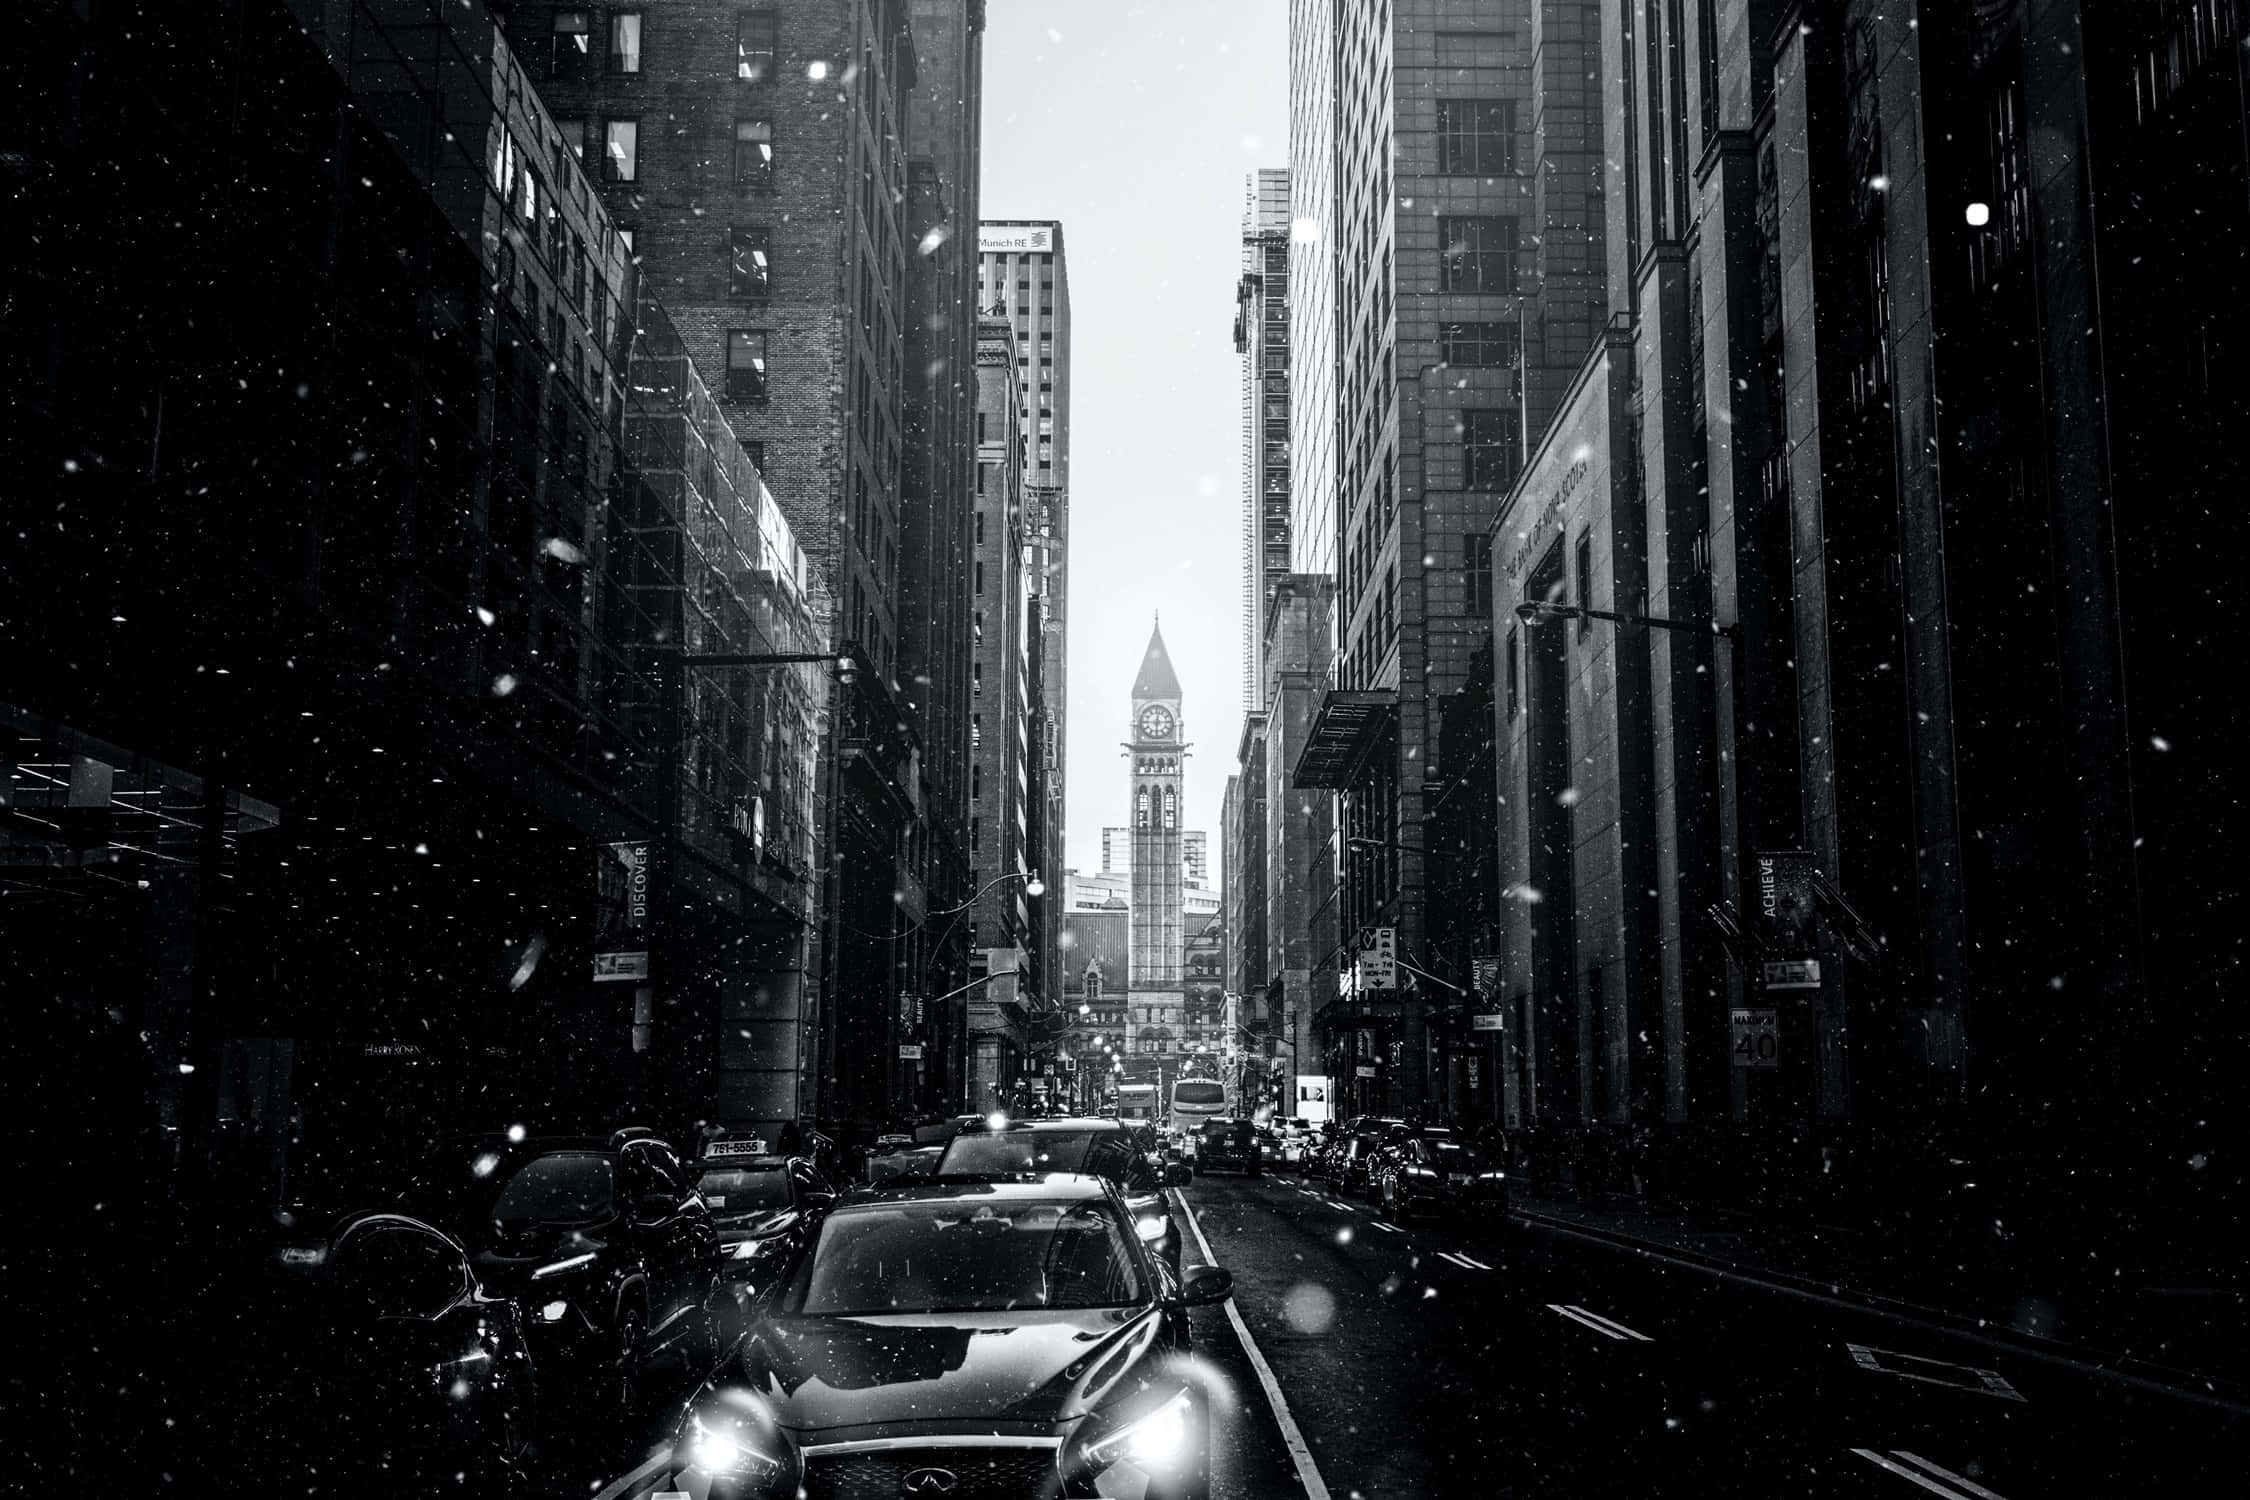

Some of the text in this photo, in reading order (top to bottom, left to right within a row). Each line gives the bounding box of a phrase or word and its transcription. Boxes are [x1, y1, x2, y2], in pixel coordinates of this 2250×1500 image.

[979, 239, 1027, 247] Munich RE
[633, 846, 648, 917] DISCOVER
[1761, 857, 1776, 918] ACHIEVE
[1473, 959, 1481, 990] BEAUTY
[1734, 1015, 1775, 1025] MAXIMUM
[1735, 1034, 1775, 1060] 40
[713, 1142, 758, 1154] 751-5555
